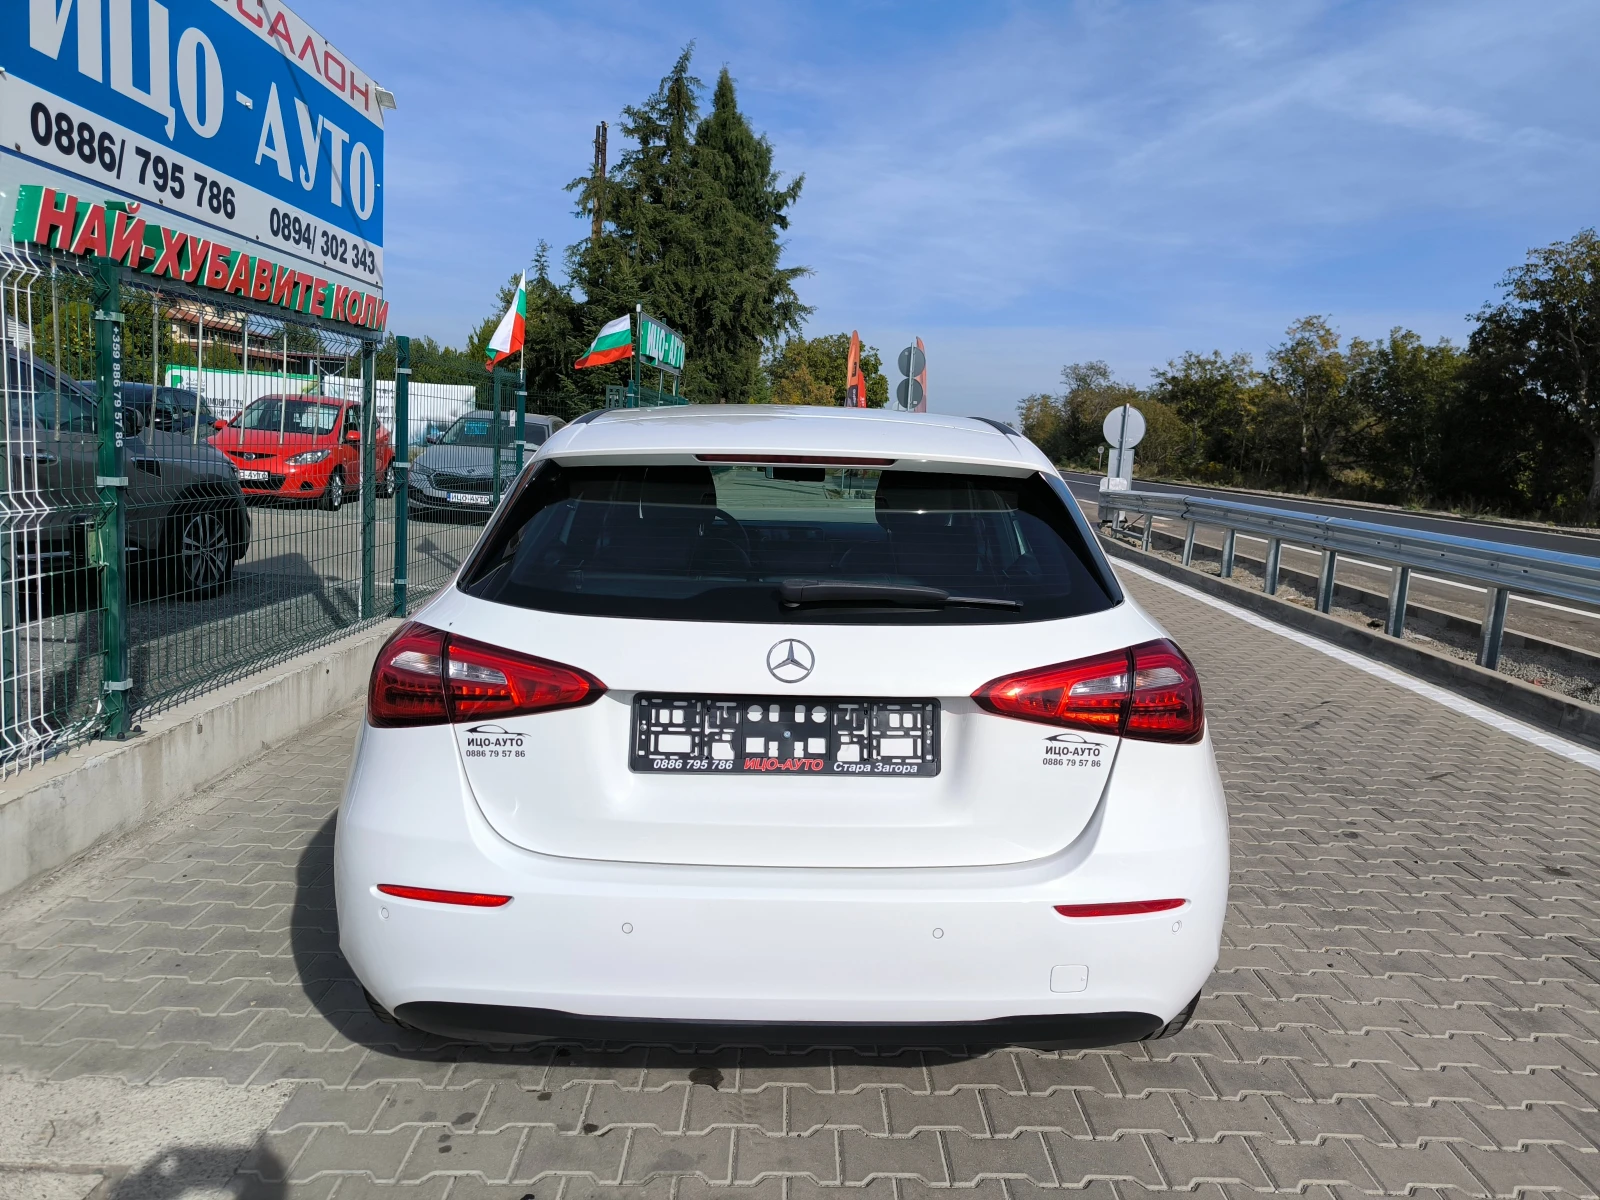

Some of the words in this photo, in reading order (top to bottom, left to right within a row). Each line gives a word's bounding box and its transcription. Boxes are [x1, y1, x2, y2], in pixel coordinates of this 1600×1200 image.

[224, 0, 370, 112] САЛОН
[30, 102, 126, 180] 0886/
[135, 145, 185, 200] 795
[194, 172, 236, 220] 786
[269, 207, 318, 256] 0894/
[320, 230, 348, 265] 302
[351, 243, 376, 276] 343
[34, 187, 328, 316] НАЙ-ХУБАВИТЕ
[331, 284, 389, 332] КОЛИ
[112, 326, 121, 359] +359
[112, 363, 121, 388] 886
[113, 391, 122, 408] 79
[114, 412, 123, 428] 57
[115, 431, 124, 448] 86
[467, 738, 524, 748] ИЦО-АУТО
[1045, 745, 1101, 757] ИЦО-АУТО
[653, 758, 683, 770] 0886
[686, 759, 709, 770] 795
[711, 759, 734, 771] 786
[744, 757, 825, 771] ИЦО-АУТО
[833, 761, 873, 775] Стара
[874, 762, 918, 775] Загора
[1042, 757, 1064, 766] 0886
[1066, 758, 1076, 766] 79
[1078, 759, 1089, 767] 57
